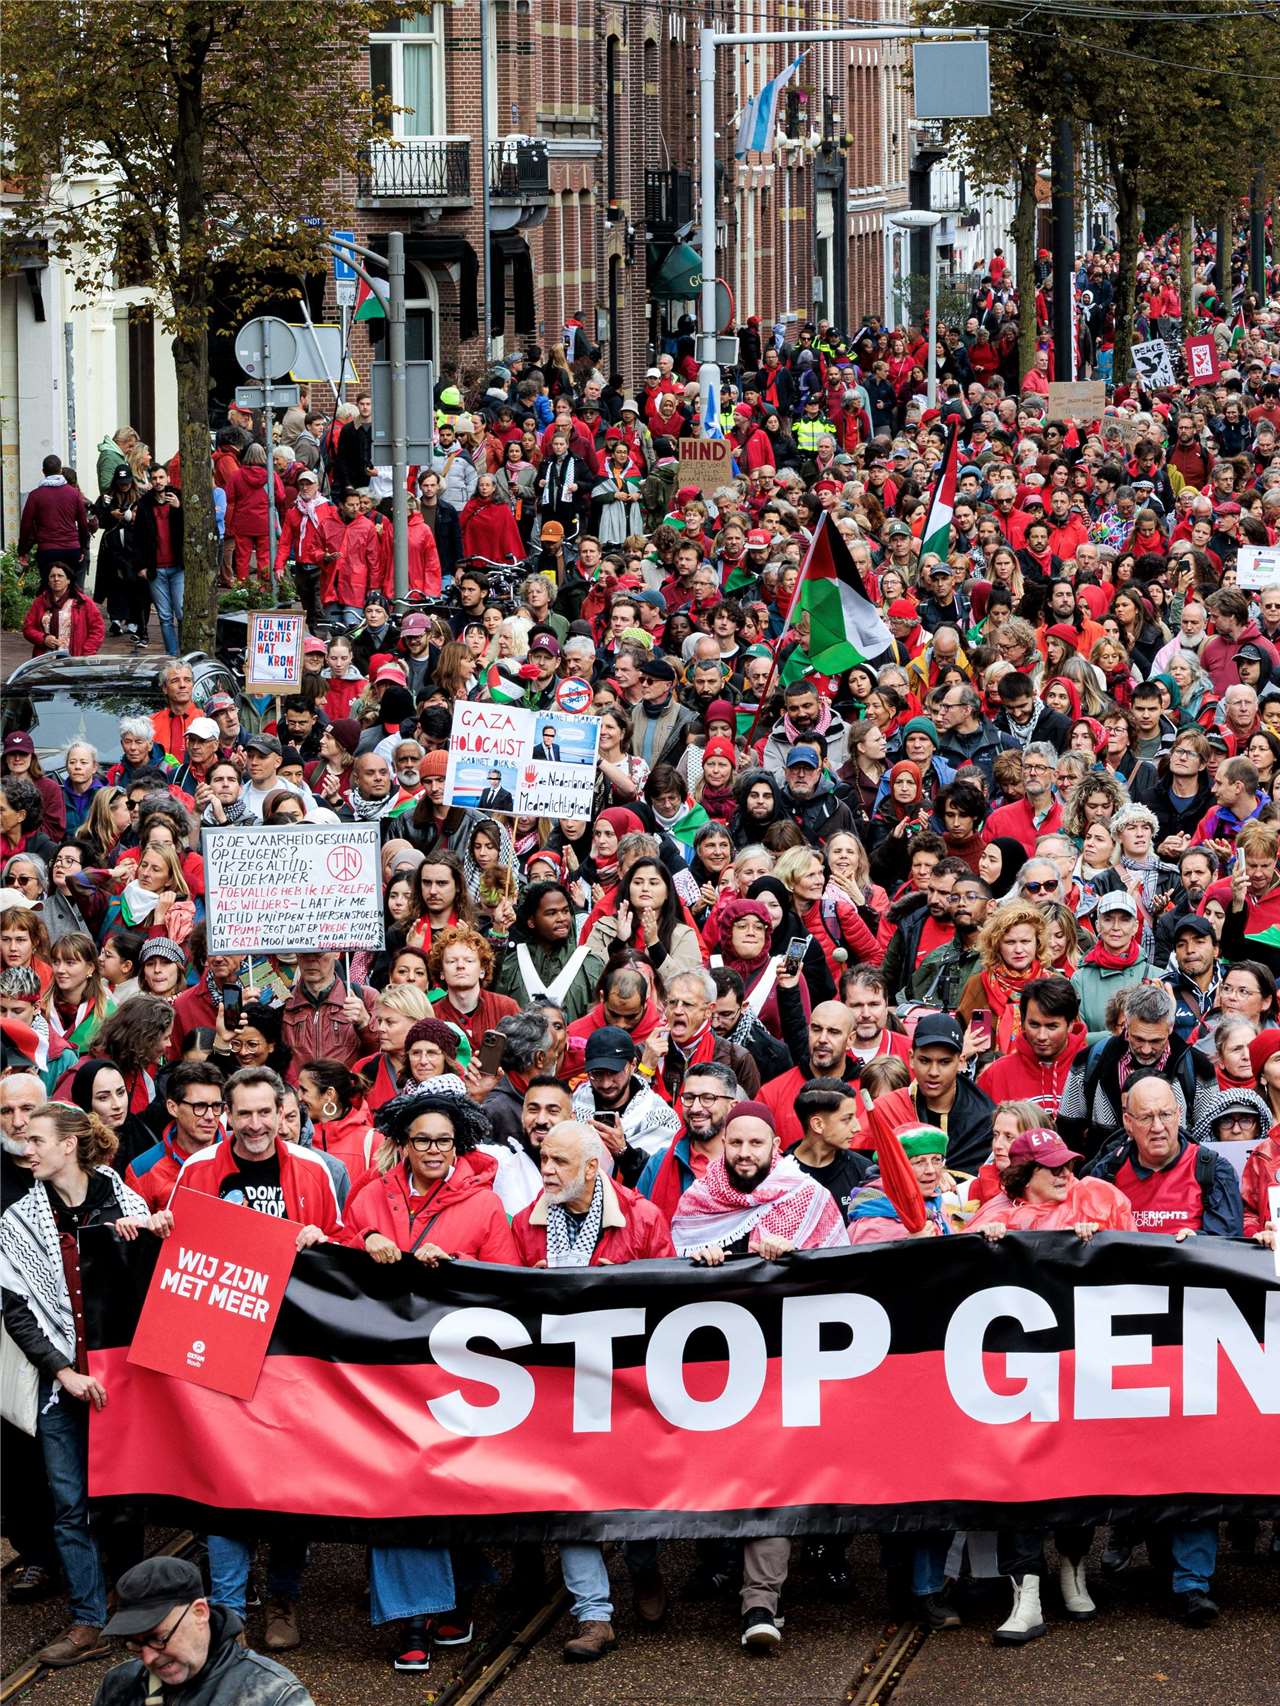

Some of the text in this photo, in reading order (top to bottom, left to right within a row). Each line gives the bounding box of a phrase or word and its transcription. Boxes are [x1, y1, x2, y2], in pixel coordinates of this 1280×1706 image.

[1134, 342, 1163, 355] PEACE
[1144, 376, 1171, 392] NOW
[682, 442, 726, 460] HIND
[258, 619, 296, 631] LUL NIET
[258, 631, 291, 642] RECHTS
[258, 643, 275, 654] WAT
[268, 656, 293, 666] KROM
[284, 668, 293, 678] IS
[462, 710, 516, 731] GAZA
[451, 733, 525, 757] HOLOCAUST
[548, 771, 594, 790] Nederlandse
[519, 792, 591, 817] Medeplichtigheid
[212, 836, 224, 848] IS
[227, 836, 244, 847] DE
[211, 850, 228, 860] OP
[238, 862, 264, 872] ZEG
[260, 872, 308, 884] KAPPER
[217, 901, 239, 911] ALS
[300, 898, 331, 909] LAAT
[350, 897, 367, 906] ME
[212, 925, 225, 935] EN
[227, 924, 261, 935] TRUMP
[263, 925, 286, 934] ZEGT
[288, 924, 305, 933] DAT
[213, 938, 231, 949] DAT
[232, 937, 259, 947] GAZA
[178, 1247, 269, 1296] WIJ ZIJN
[160, 1268, 270, 1323] MET MEER
[426, 1292, 891, 1438] STOP
